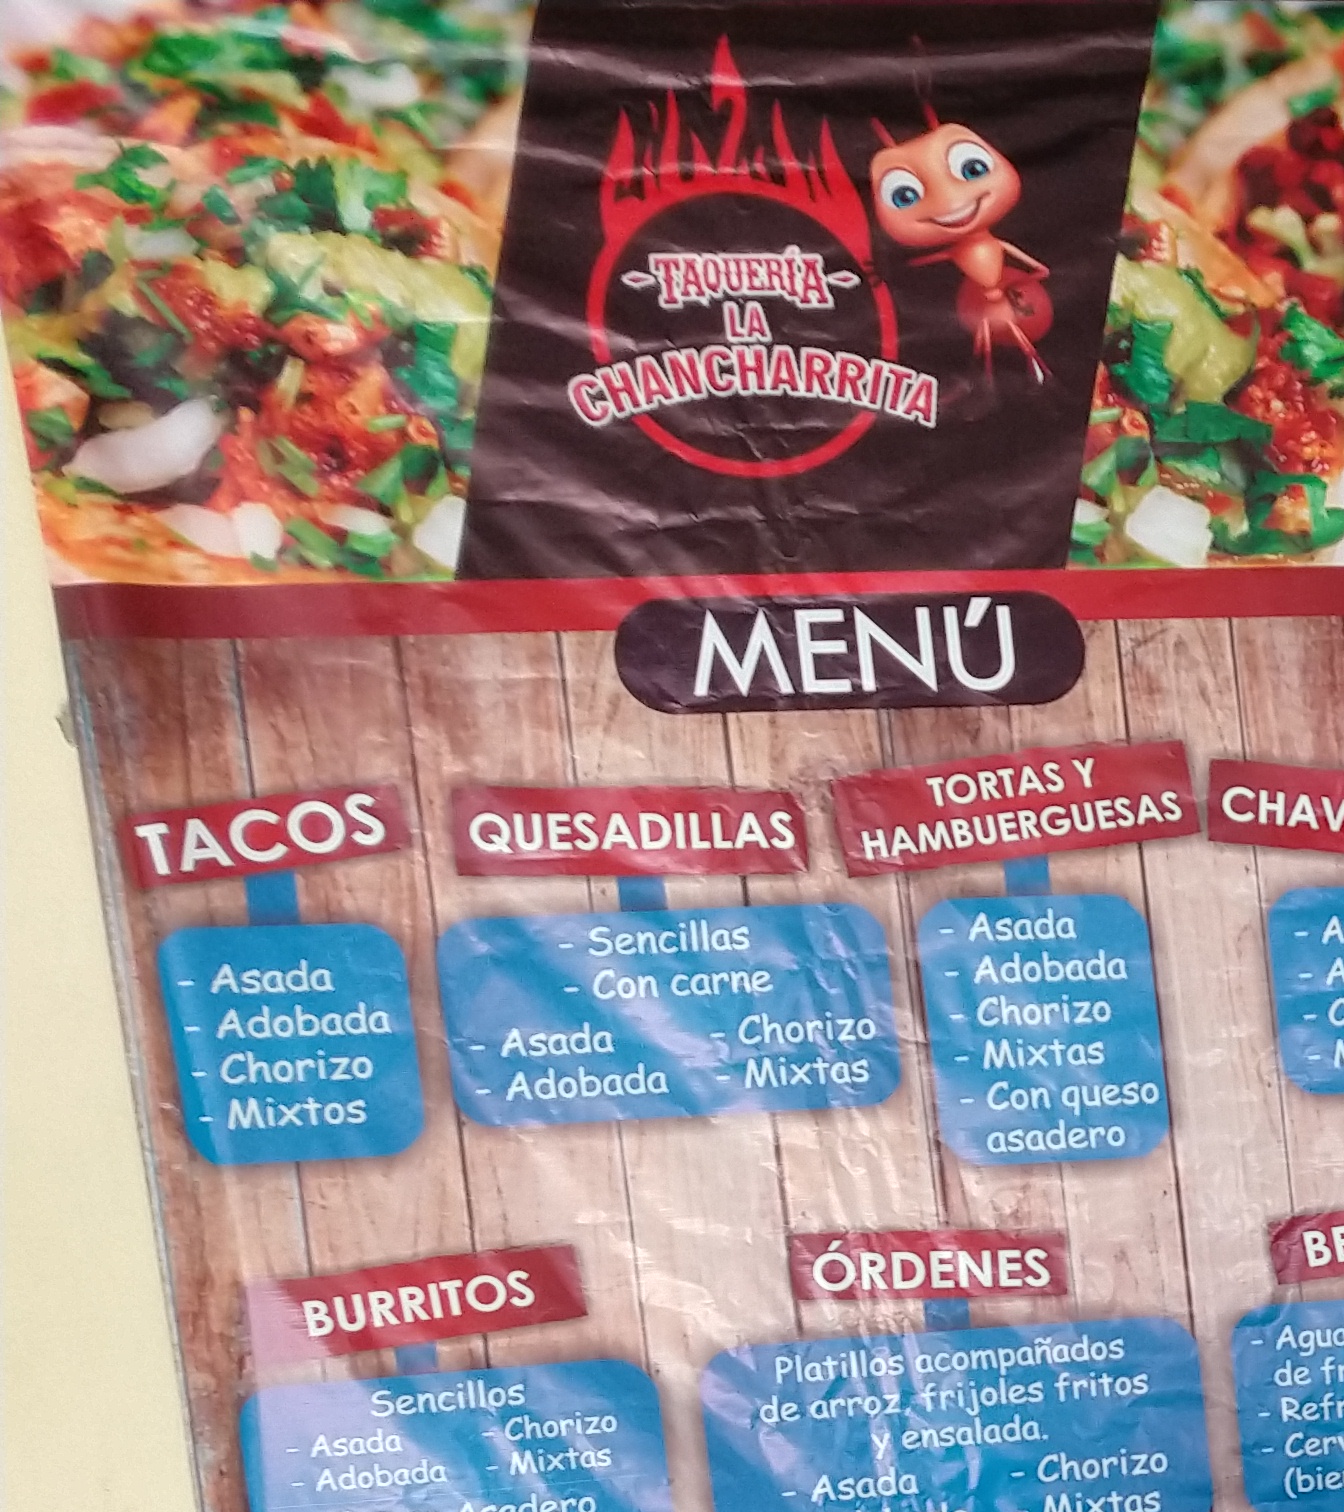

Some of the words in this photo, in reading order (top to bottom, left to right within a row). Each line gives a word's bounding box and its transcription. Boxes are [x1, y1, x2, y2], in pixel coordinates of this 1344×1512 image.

[650, 244, 833, 309] TAQUERÍA
[723, 302, 770, 341] LA
[568, 344, 938, 427] CHANCHARRITA
[694, 596, 1015, 697] MENÚ
[926, 761, 1063, 805] TORTAS
[1072, 758, 1095, 789] Y
[136, 793, 388, 875] TACOS
[469, 811, 795, 853] QUESADILLAS
[861, 791, 1182, 859] HAMBUERGUESAS
[588, 922, 750, 959] Sencillas
[969, 912, 1076, 942] Asada
[210, 966, 334, 993] Asada
[592, 969, 664, 1000] Con
[671, 969, 773, 997] carne
[974, 952, 1128, 984] Adobada
[217, 1006, 392, 1038] Adobada
[977, 994, 1111, 1028] Chorizo
[501, 1024, 614, 1058] Asada
[738, 1014, 876, 1046] Chorizo
[219, 1051, 374, 1085] Chorizo
[984, 1039, 1105, 1068] Mixtas
[506, 1068, 669, 1101] Adobada
[744, 1059, 869, 1089] Mixtas
[227, 1098, 367, 1128] Mixtos
[988, 1082, 1051, 1110] Con
[1061, 1081, 1159, 1118] queso
[987, 1122, 1126, 1153] asadero
[811, 1241, 1051, 1293] ÓRDENES
[303, 1269, 535, 1338] BURRITOS
[774, 1345, 904, 1386] Platillos
[915, 1334, 1126, 1382] acompañados
[1274, 1360, 1310, 1386] de
[371, 1380, 526, 1418] Sencillos
[760, 1396, 798, 1422] de
[922, 1376, 1046, 1420] frijoles
[1054, 1368, 1149, 1403] fritos
[311, 1430, 402, 1458] Asada
[504, 1413, 618, 1442] Chorizo
[871, 1428, 890, 1462] y
[900, 1415, 1050, 1452] ensalada.
[316, 1460, 447, 1491] Adobada
[510, 1444, 612, 1475] Mixtas
[1037, 1450, 1169, 1486] Chorizo
[810, 1468, 919, 1503] Asada
